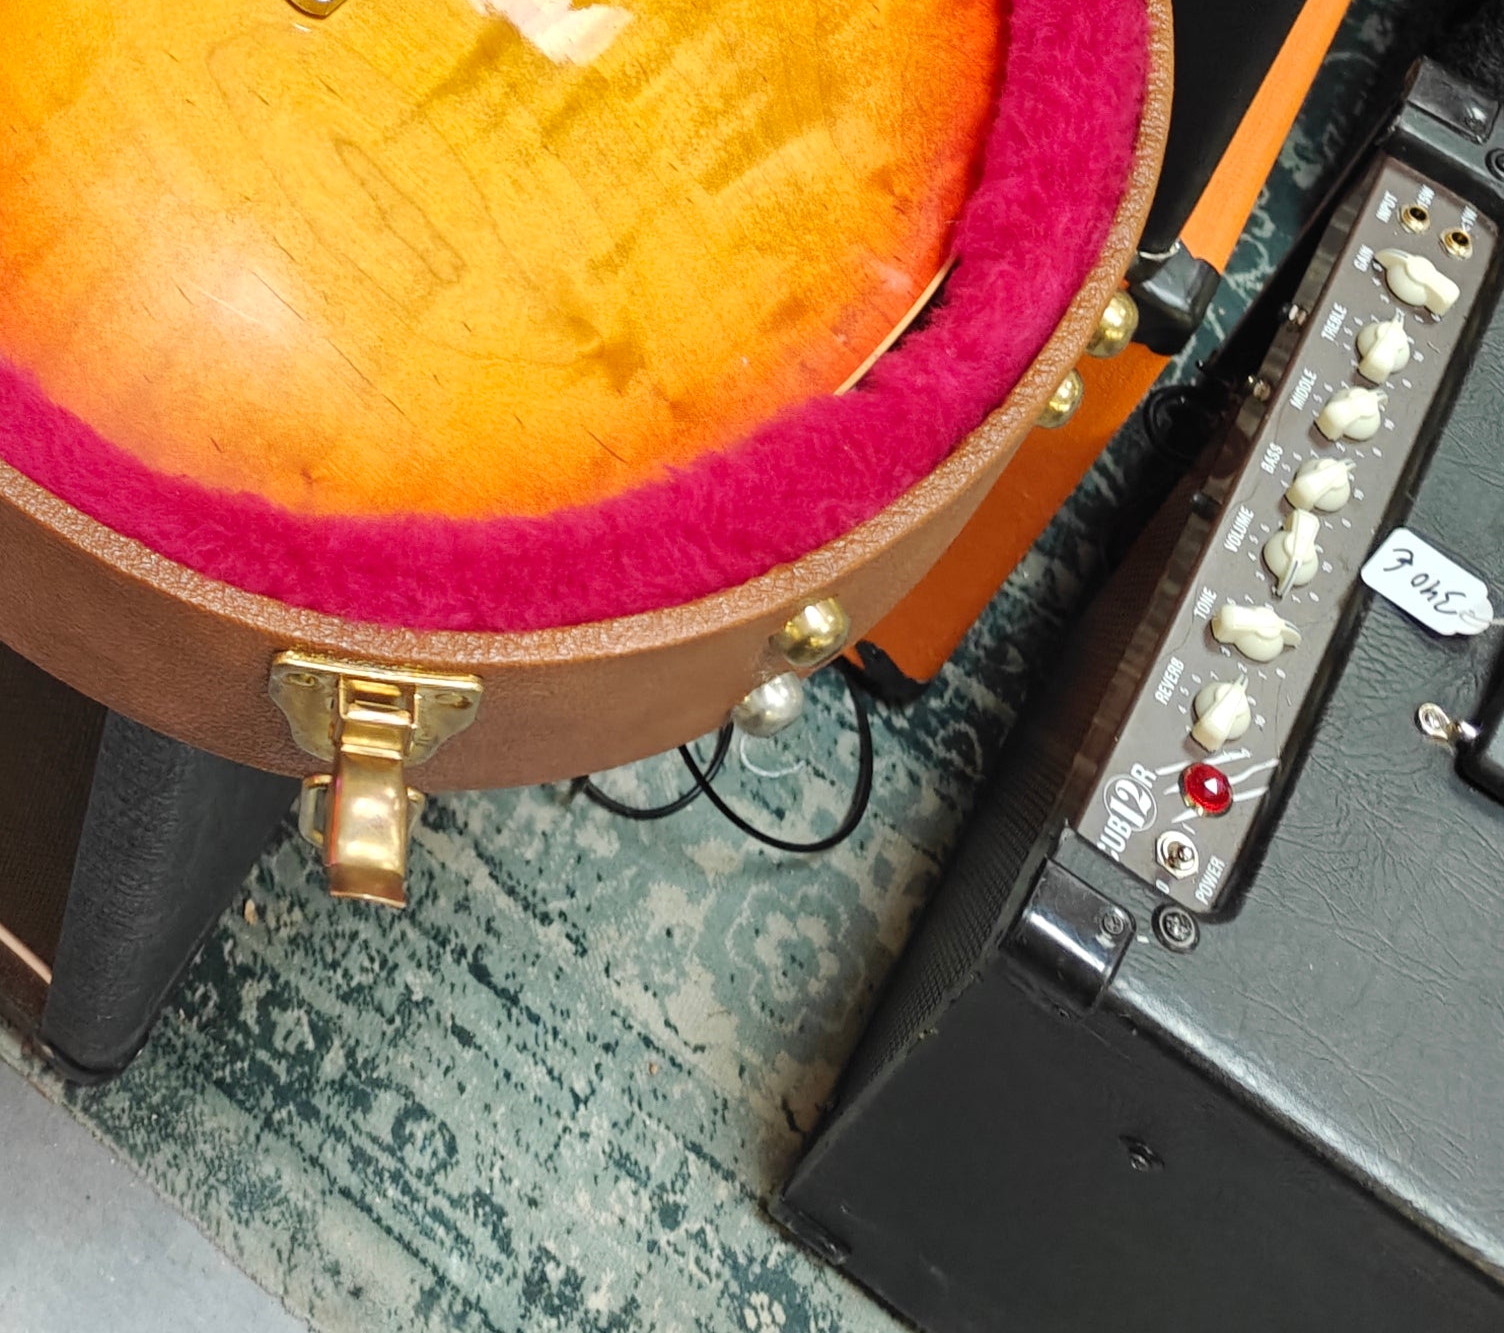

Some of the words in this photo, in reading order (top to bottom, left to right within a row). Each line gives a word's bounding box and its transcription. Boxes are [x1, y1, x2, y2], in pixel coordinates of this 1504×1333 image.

[1376, 190, 1398, 223] INPUT
[1353, 244, 1374, 272] GAIN
[1321, 302, 1347, 341] TREBLE
[1289, 368, 1317, 411] MIDDLE
[1260, 442, 1284, 475] BASS
[1223, 505, 1254, 553] VOLUME
[1193, 586, 1217, 620] TONE
[1410, 573, 1467, 615] 340
[1155, 656, 1184, 706] REVERB
[1196, 855, 1226, 905] POWER
